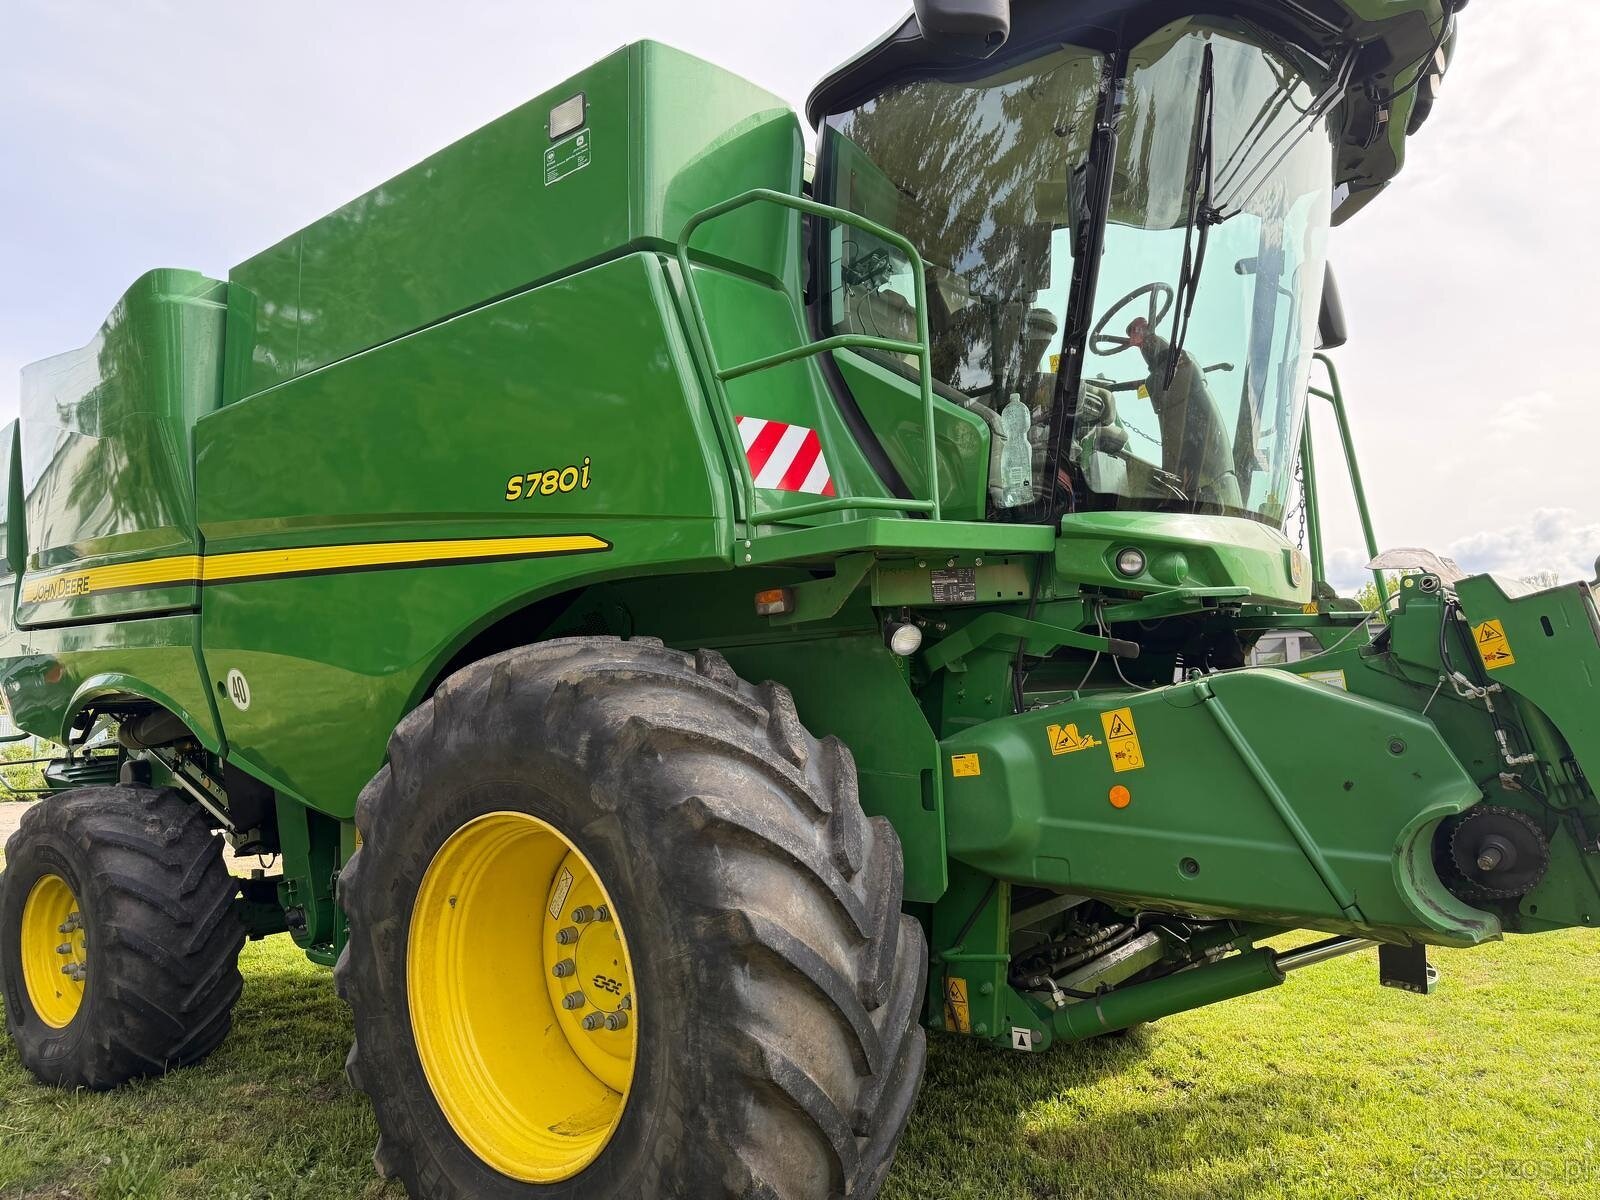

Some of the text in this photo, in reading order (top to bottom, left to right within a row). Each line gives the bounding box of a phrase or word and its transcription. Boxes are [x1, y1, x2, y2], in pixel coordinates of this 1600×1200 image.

[505, 456, 591, 501] S780i
[32, 576, 90, 600] JOHN DEERE
[232, 676, 247, 703] 40
